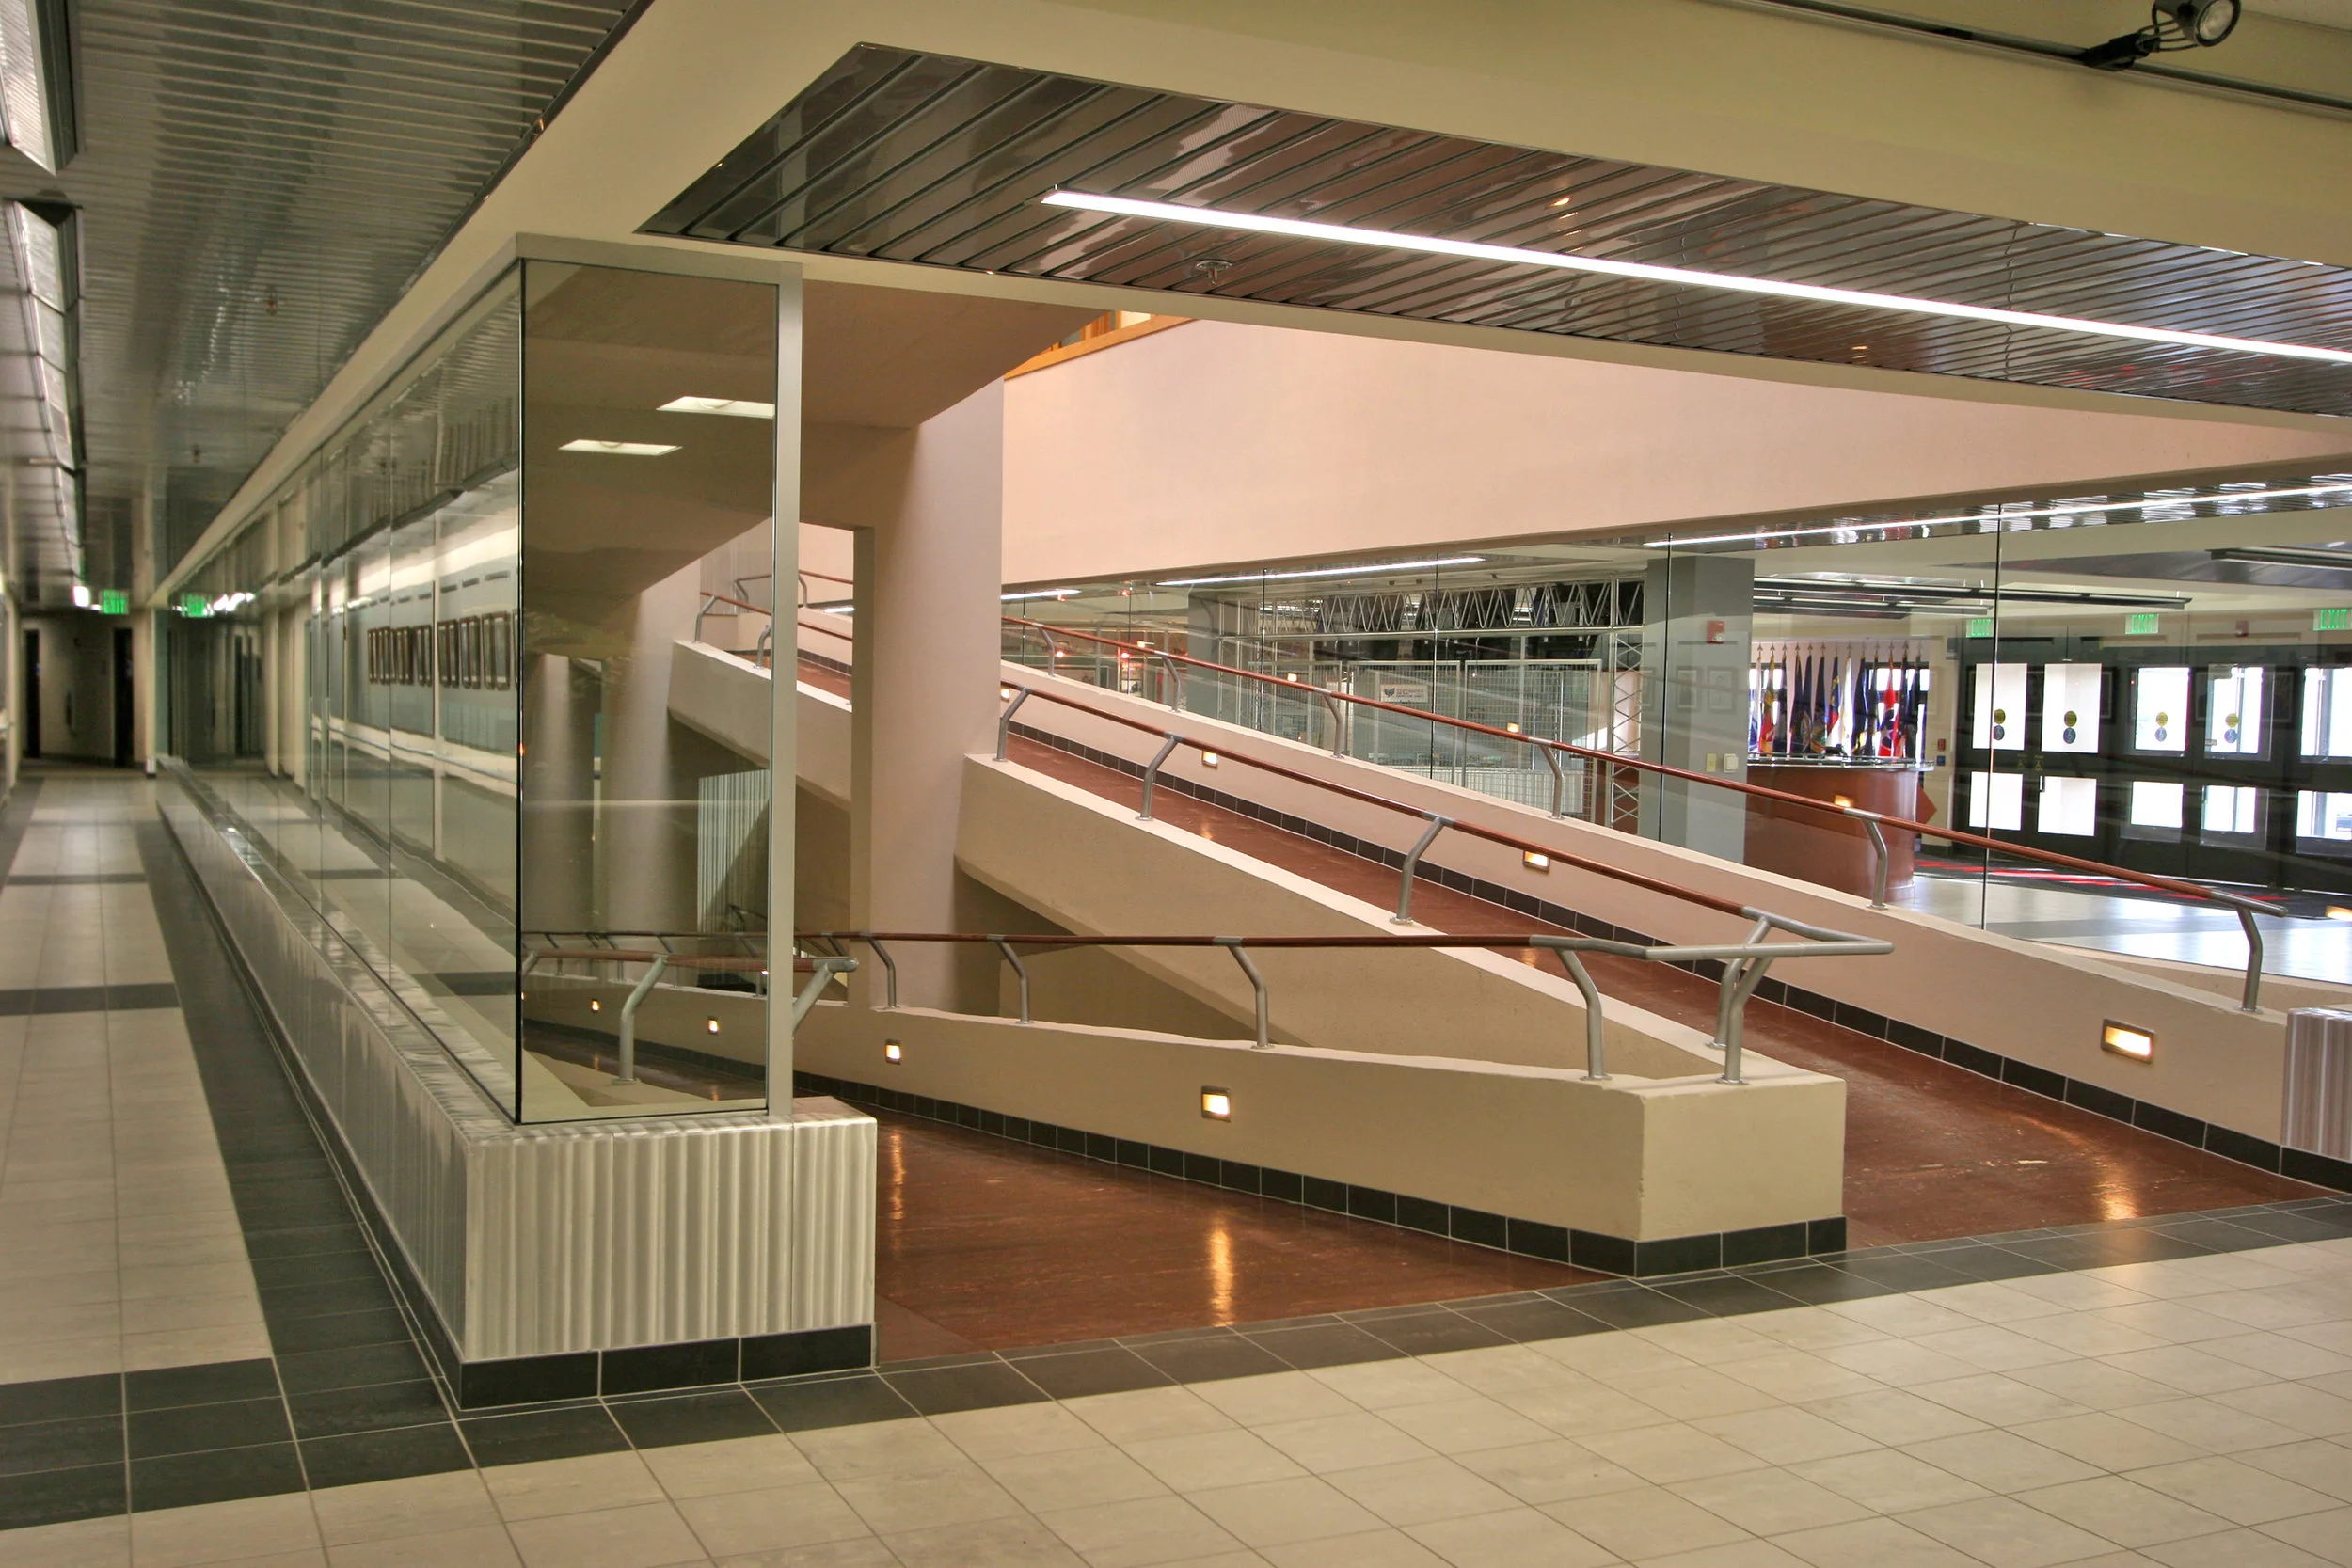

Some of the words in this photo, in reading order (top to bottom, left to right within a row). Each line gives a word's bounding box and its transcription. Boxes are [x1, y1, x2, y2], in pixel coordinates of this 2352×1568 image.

[1971, 619, 1993, 637] EXIT
[2132, 614, 2155, 633] EXIT
[2320, 609, 2348, 629] EXIT
